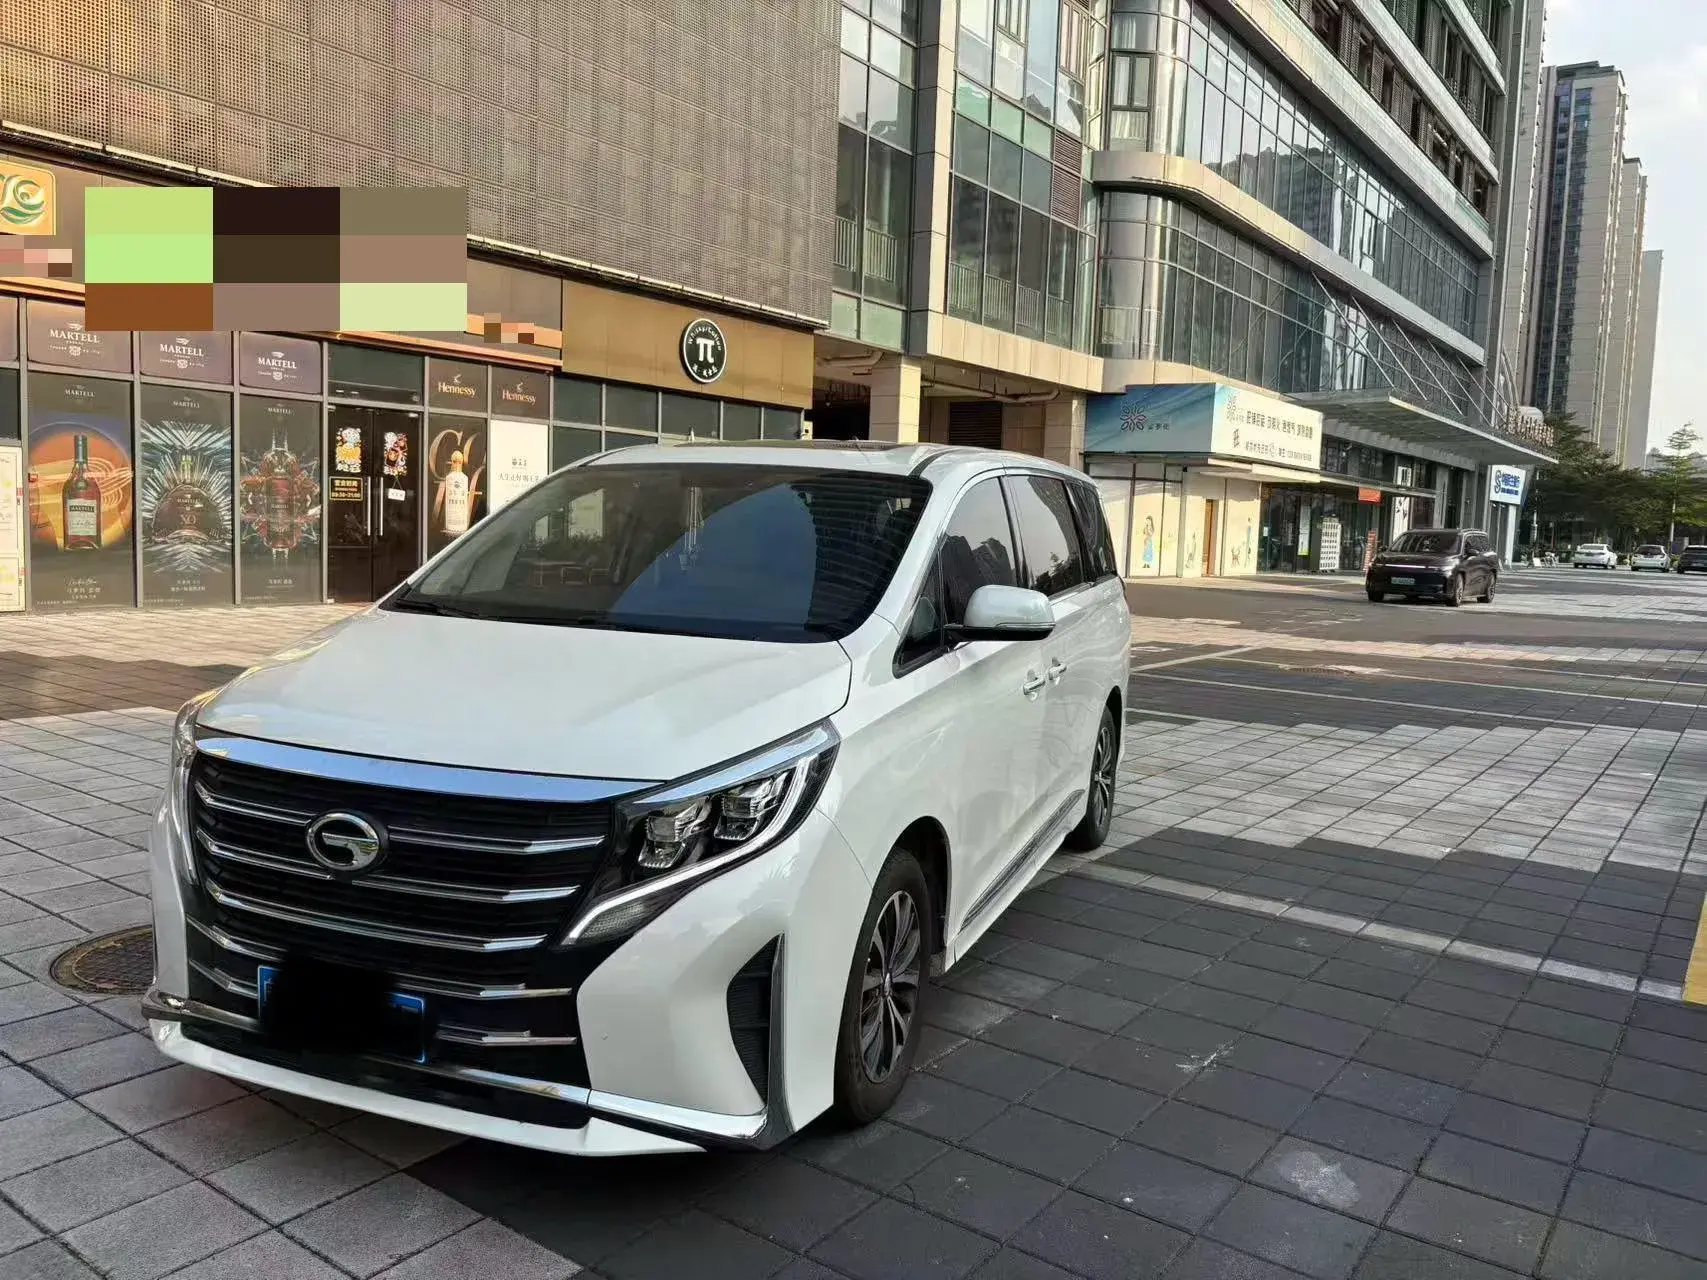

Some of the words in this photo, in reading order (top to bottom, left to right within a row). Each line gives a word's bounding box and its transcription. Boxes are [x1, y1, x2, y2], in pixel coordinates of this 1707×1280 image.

[49, 328, 101, 344] MARTELL
[159, 343, 205, 357] MARTELL
[258, 356, 298, 370] MARTELL
[64, 388, 96, 398] MARTELL
[438, 381, 477, 398] Hennessy
[502, 389, 537, 405] Hennessy
[172, 400, 200, 409] MARTELL
[267, 406, 292, 415] MARTELL
